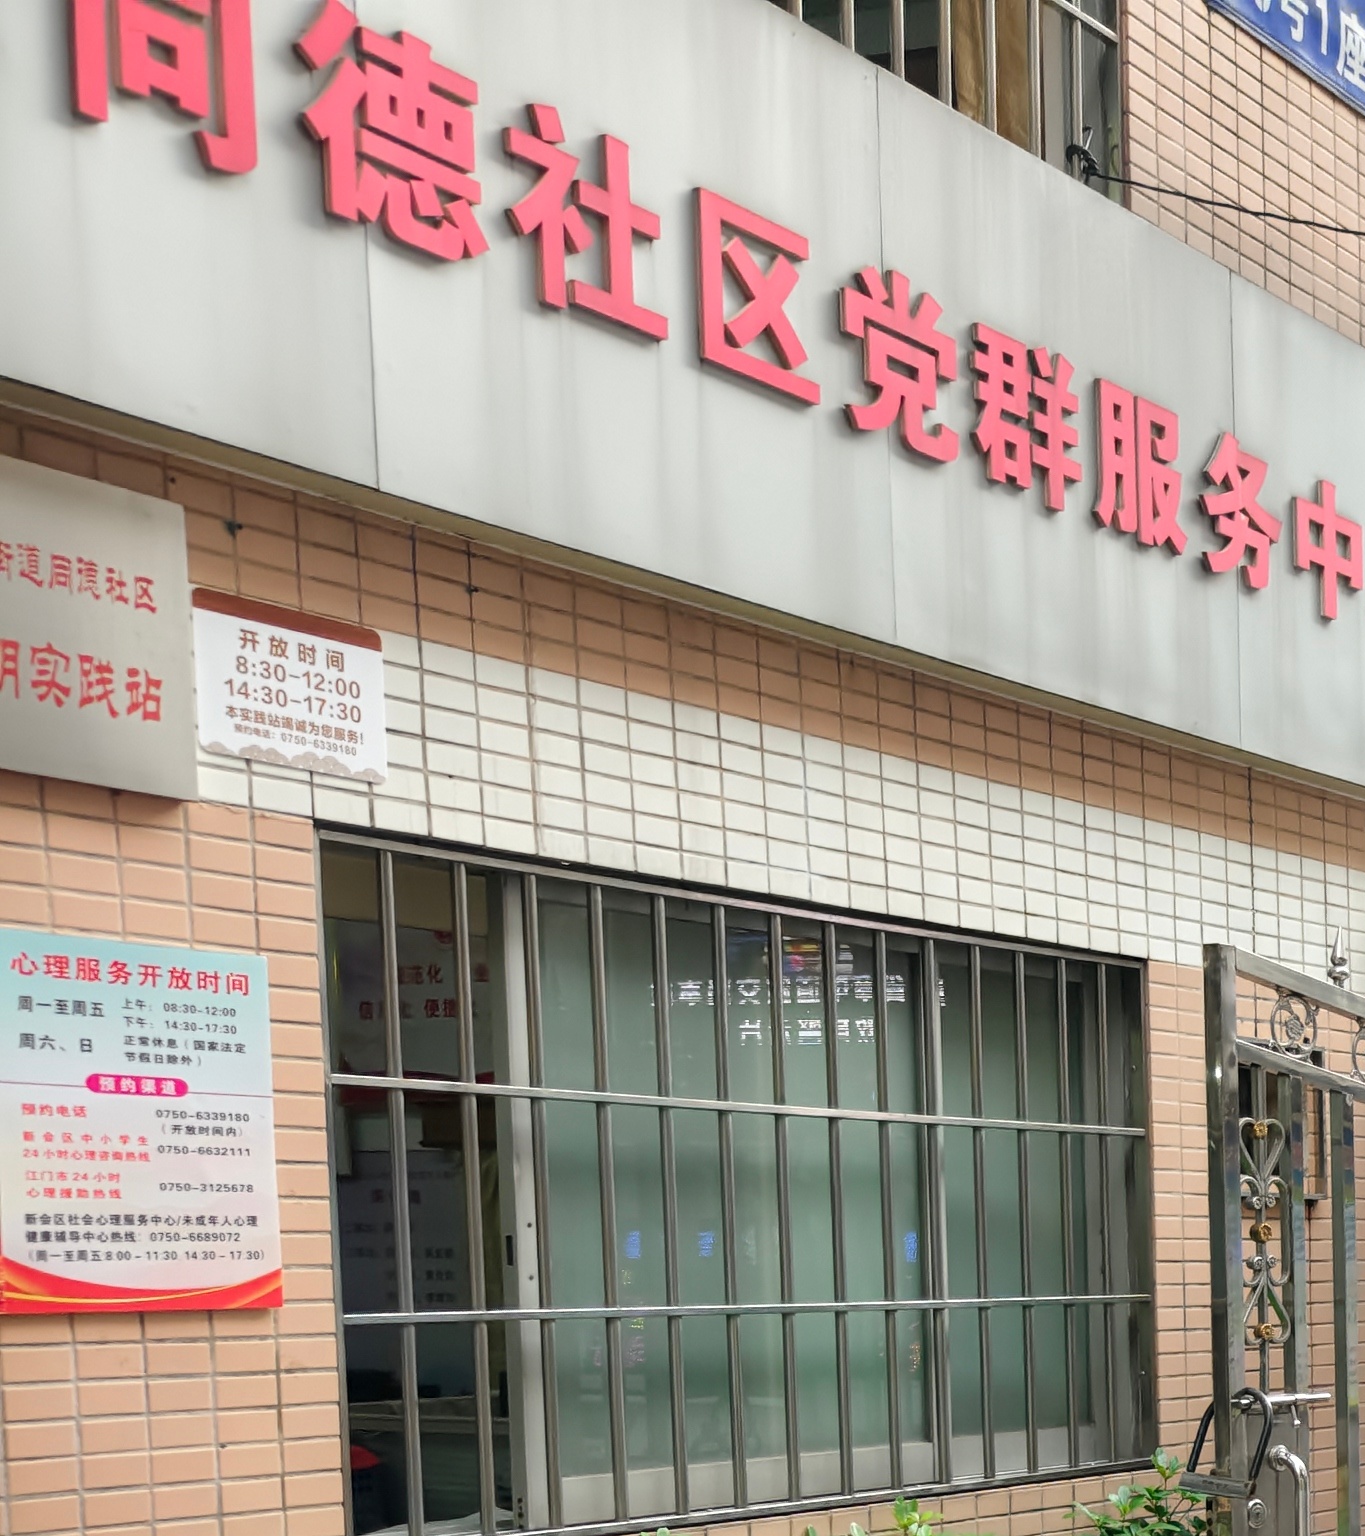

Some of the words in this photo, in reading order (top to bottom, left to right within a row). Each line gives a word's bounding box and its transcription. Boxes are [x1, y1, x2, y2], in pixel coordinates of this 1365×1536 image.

[238, 628, 346, 674] 开放时间
[235, 655, 362, 700] 8:30-12:00
[224, 678, 362, 724] 14:30-17:30
[280, 731, 358, 757] 0750-6339180
[10, 951, 251, 997] 心理服务开放时间
[17, 995, 106, 1019] 周一至周五
[163, 1002, 237, 1018] 08:30-12:00
[164, 1020, 238, 1036] 14:30-17:30
[98, 1076, 178, 1096] 预约渠道
[20, 1103, 88, 1119] 预约电话
[155, 1109, 251, 1123] 0750-6339180
[22, 1131, 149, 1147] 新会区中小学生
[156, 1145, 252, 1158] 0750-6632111
[26, 1187, 122, 1200] 心理援助热线
[159, 1182, 255, 1195] 0750-3125678
[150, 1231, 242, 1244] 0750-6689072
